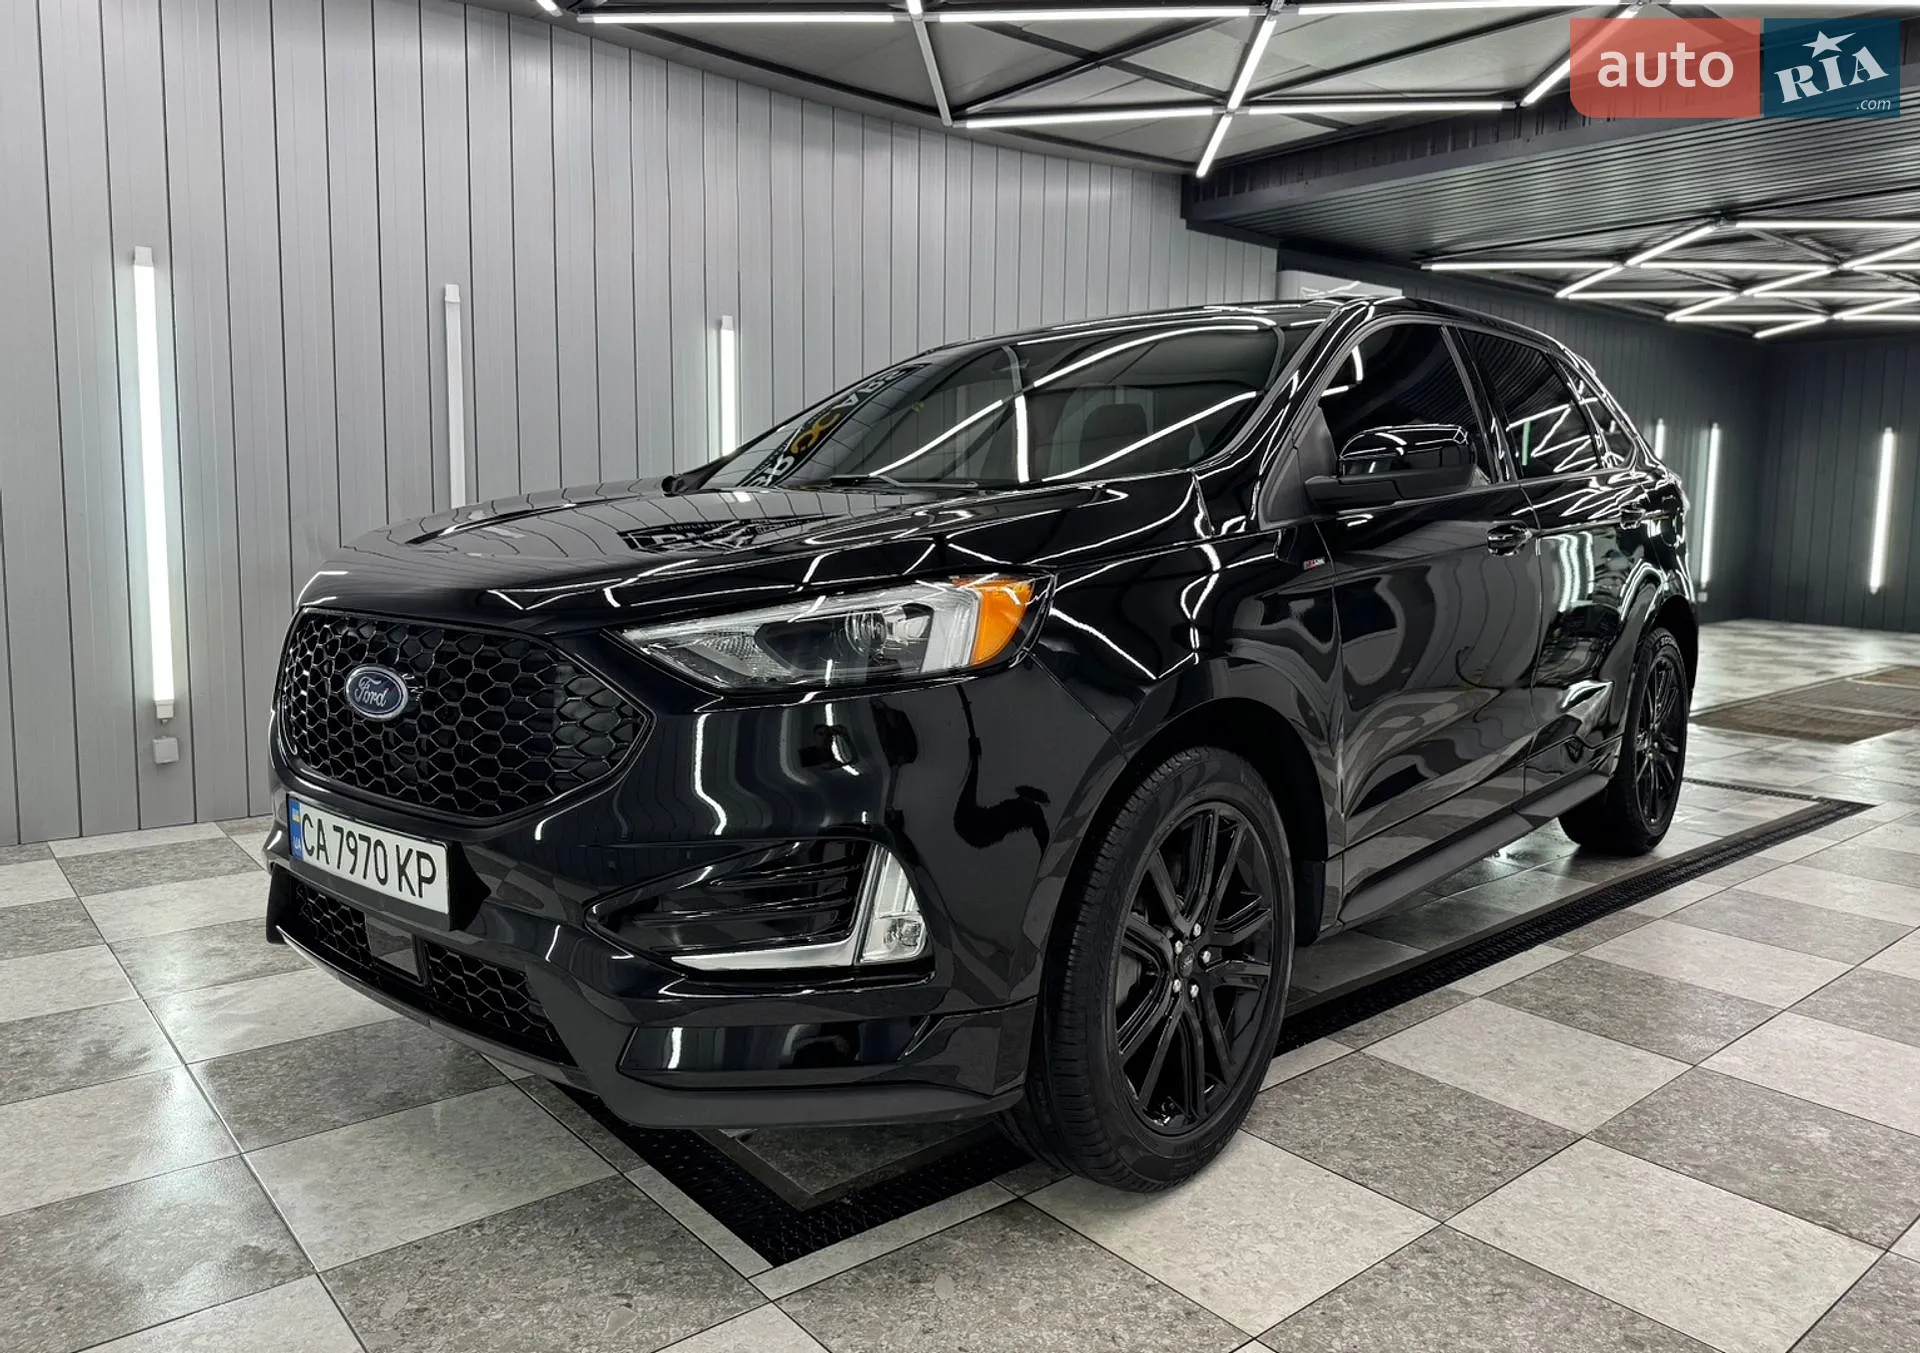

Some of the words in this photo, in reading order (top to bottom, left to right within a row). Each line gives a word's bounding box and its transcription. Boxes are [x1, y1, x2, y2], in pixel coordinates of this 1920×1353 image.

[355, 676, 389, 707] Ford
[302, 813, 329, 865] CA
[333, 826, 389, 886] 7970
[396, 844, 437, 899] KP
